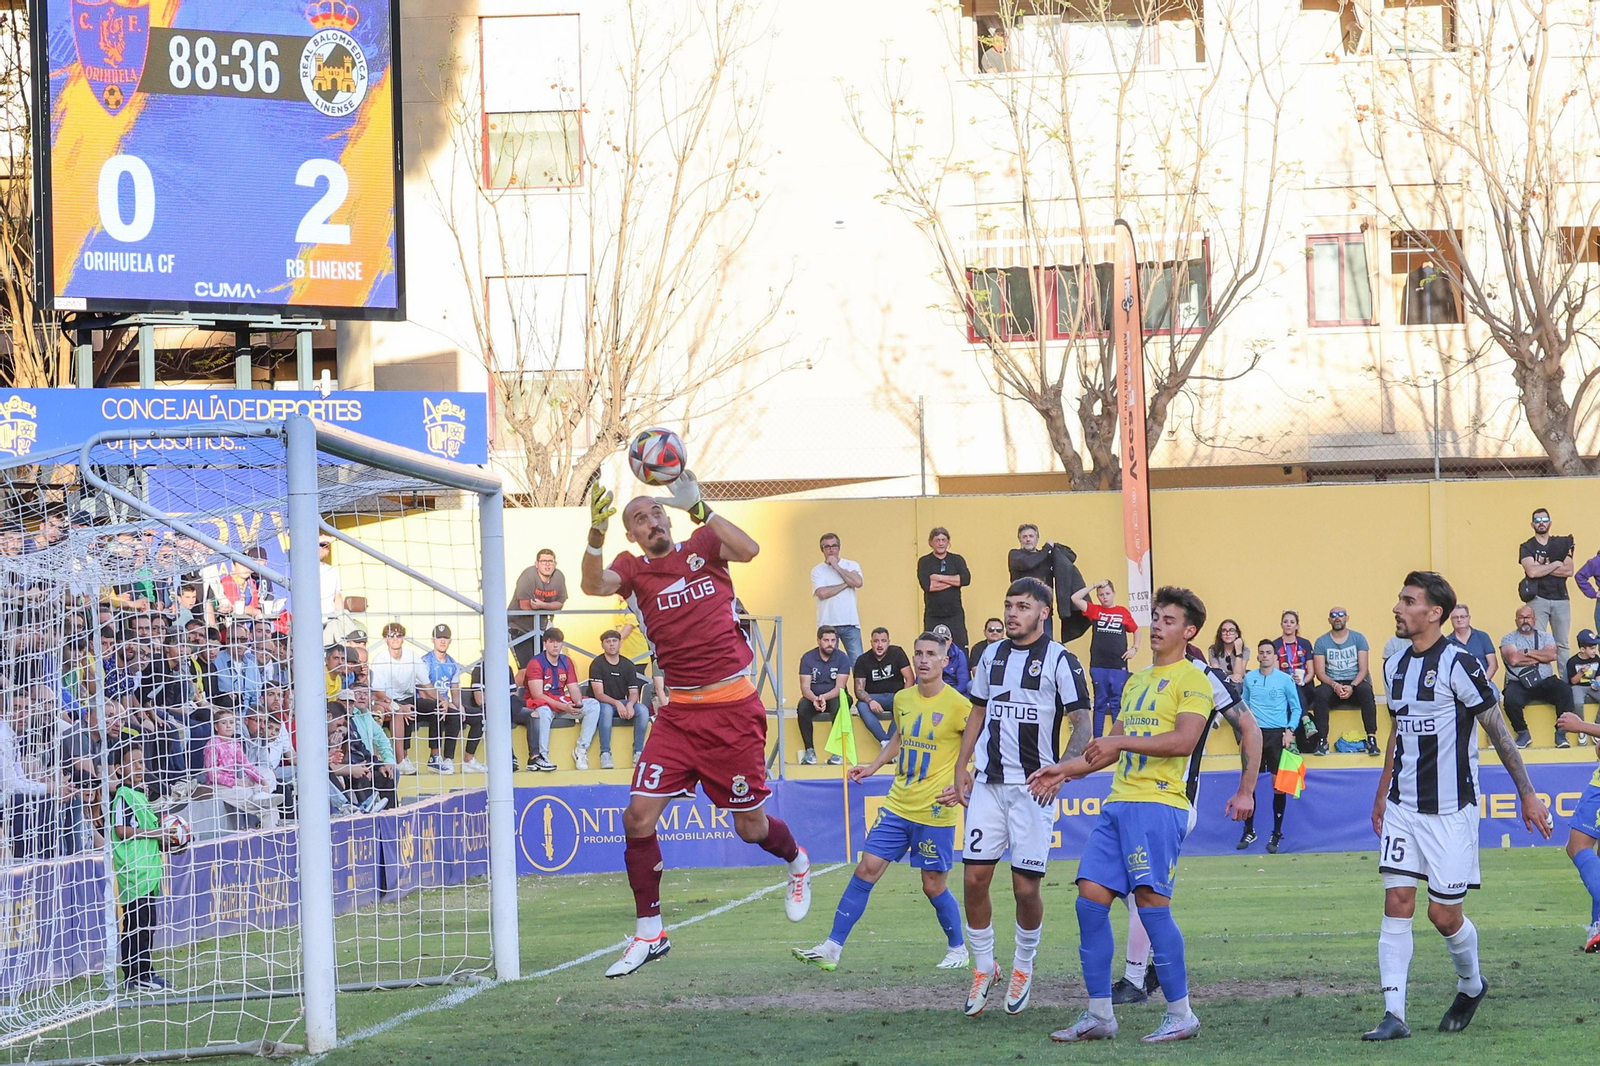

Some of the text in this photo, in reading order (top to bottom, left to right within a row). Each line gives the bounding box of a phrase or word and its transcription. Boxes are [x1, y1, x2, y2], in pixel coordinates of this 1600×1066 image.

[168, 35, 280, 93] 88:36
[302, 32, 366, 81] REAL BALOMPEDICA
[85, 66, 138, 83] ORIHUELA
[315, 98, 355, 114] LINENSE
[98, 154, 156, 243] 0
[294, 158, 351, 245] 2
[84, 251, 175, 274] ORIHUELA CF
[285, 259, 363, 280] RB LINENSE
[657, 580, 716, 611] LOTUS
[1328, 649, 1355, 661] BRKLN
[990, 704, 1038, 721] LOTUS
[1124, 715, 1160, 728] johnson
[1397, 718, 1435, 733] OTUS
[902, 739, 938, 751] johnson
[635, 761, 664, 790] 13
[729, 795, 755, 803] LEGEA
[656, 831, 735, 841] NMOBILIARIA
[970, 828, 983, 853] 2
[1384, 835, 1406, 863] 15
